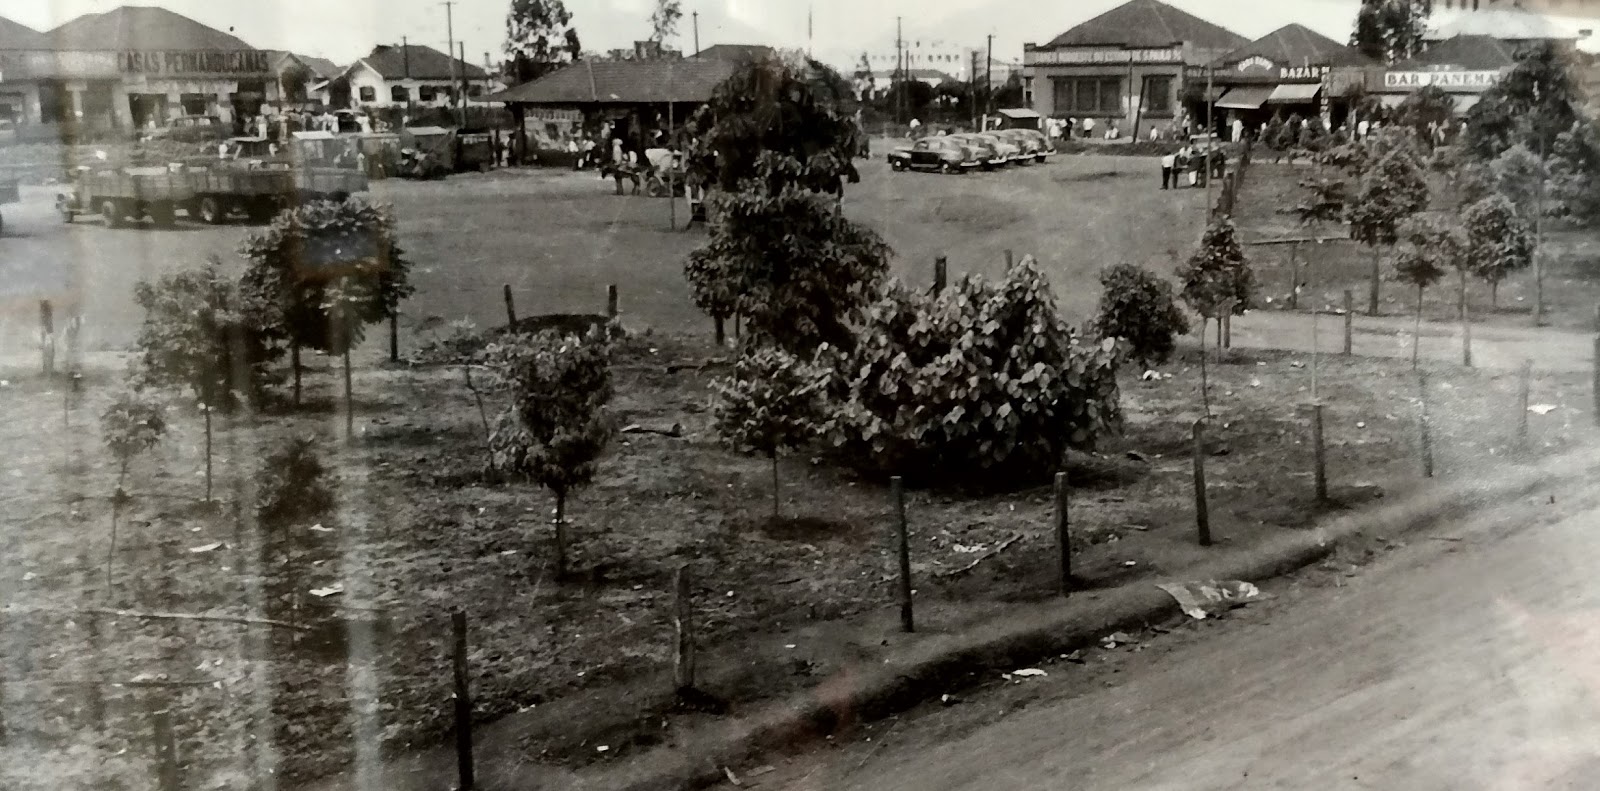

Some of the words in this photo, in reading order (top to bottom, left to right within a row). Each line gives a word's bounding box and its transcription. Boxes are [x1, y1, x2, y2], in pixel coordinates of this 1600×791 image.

[118, 52, 160, 73] CASAS
[1280, 68, 1320, 79] BAZAR
[1388, 73, 1420, 85] BAR
[1430, 73, 1496, 85] PANEMA
